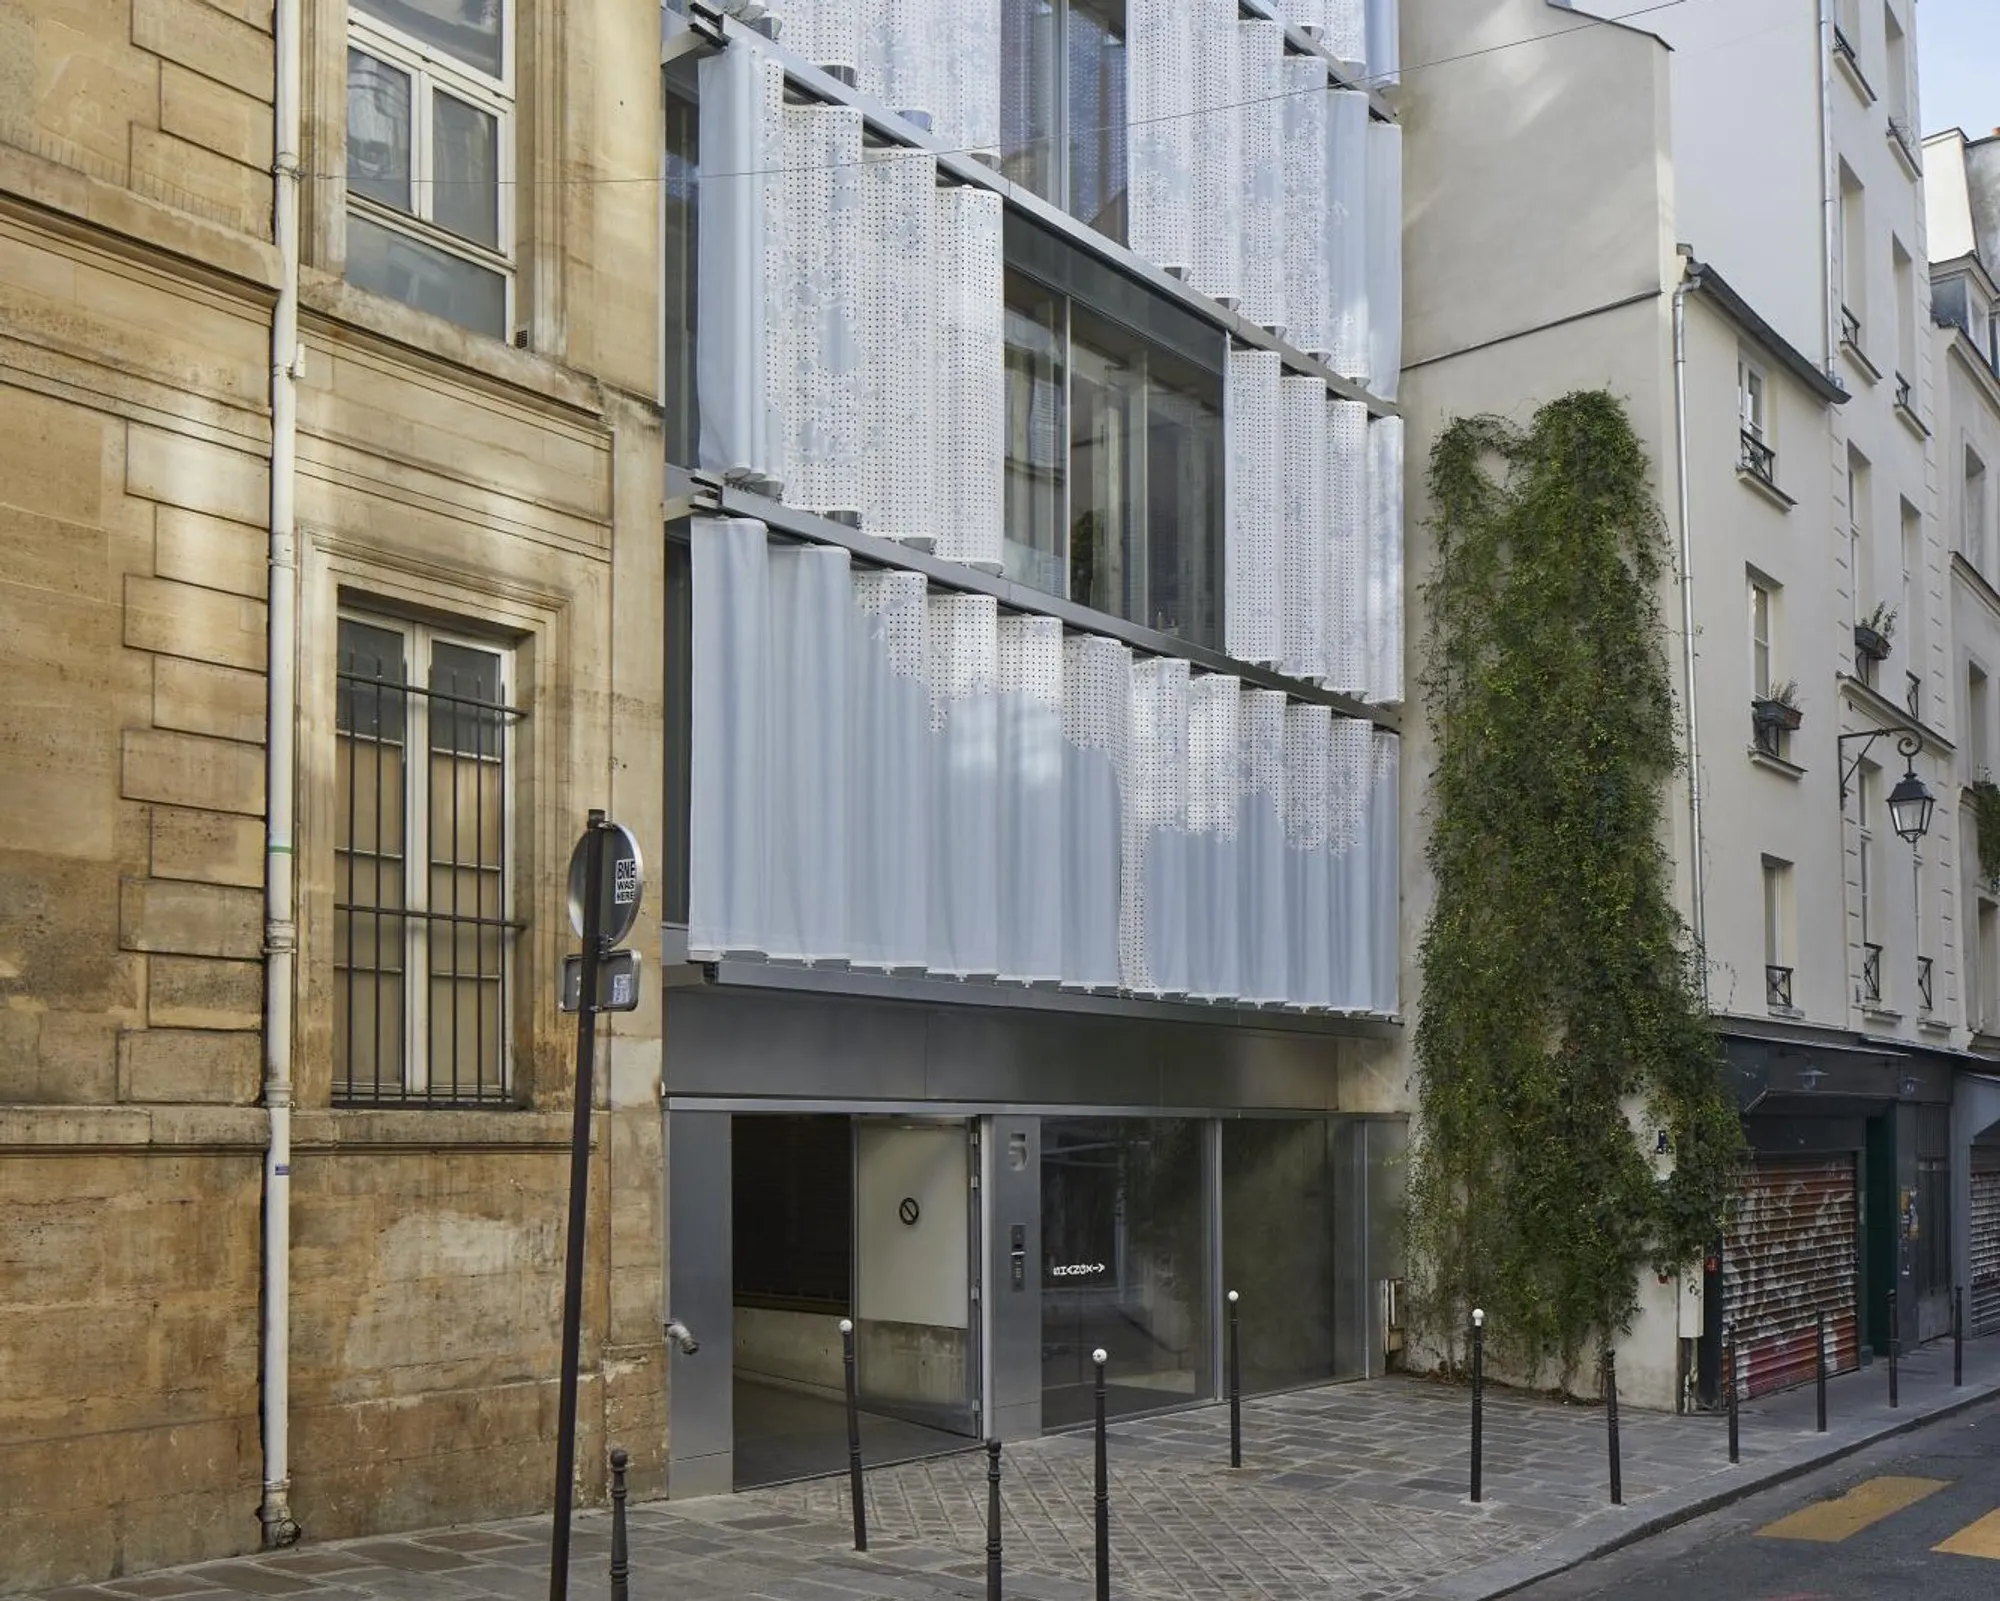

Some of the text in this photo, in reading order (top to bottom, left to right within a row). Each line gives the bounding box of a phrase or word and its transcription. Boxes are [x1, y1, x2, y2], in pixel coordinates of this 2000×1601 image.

[617, 861, 635, 879] BNE
[617, 880, 635, 890] WAS
[617, 890, 635, 901] HERE
[1008, 1132, 1027, 1171] 5
